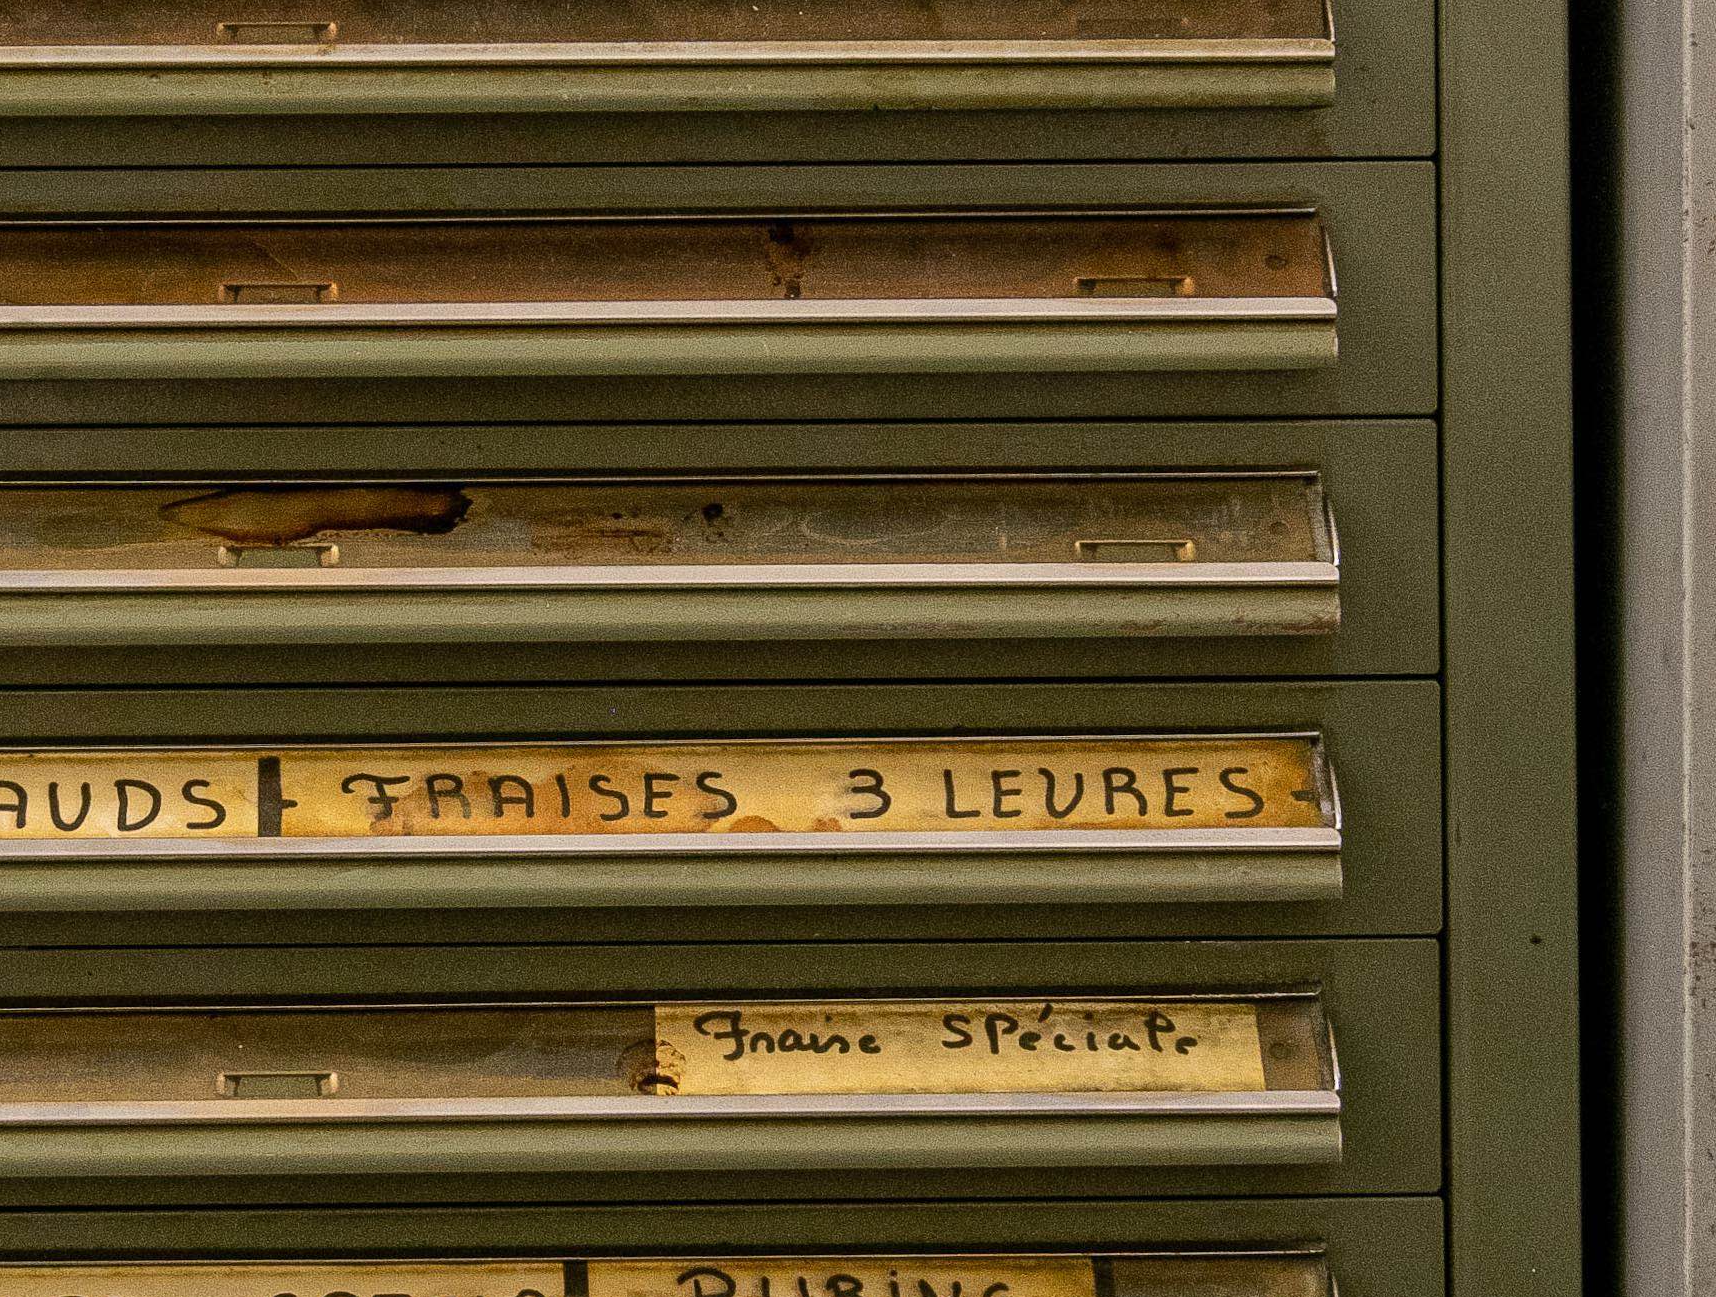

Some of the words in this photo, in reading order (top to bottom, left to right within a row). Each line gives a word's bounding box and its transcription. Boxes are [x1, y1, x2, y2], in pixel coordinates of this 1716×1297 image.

[339, 769, 738, 823] FRAISES
[848, 768, 893, 820] 3
[942, 765, 1265, 820] LEVRES
